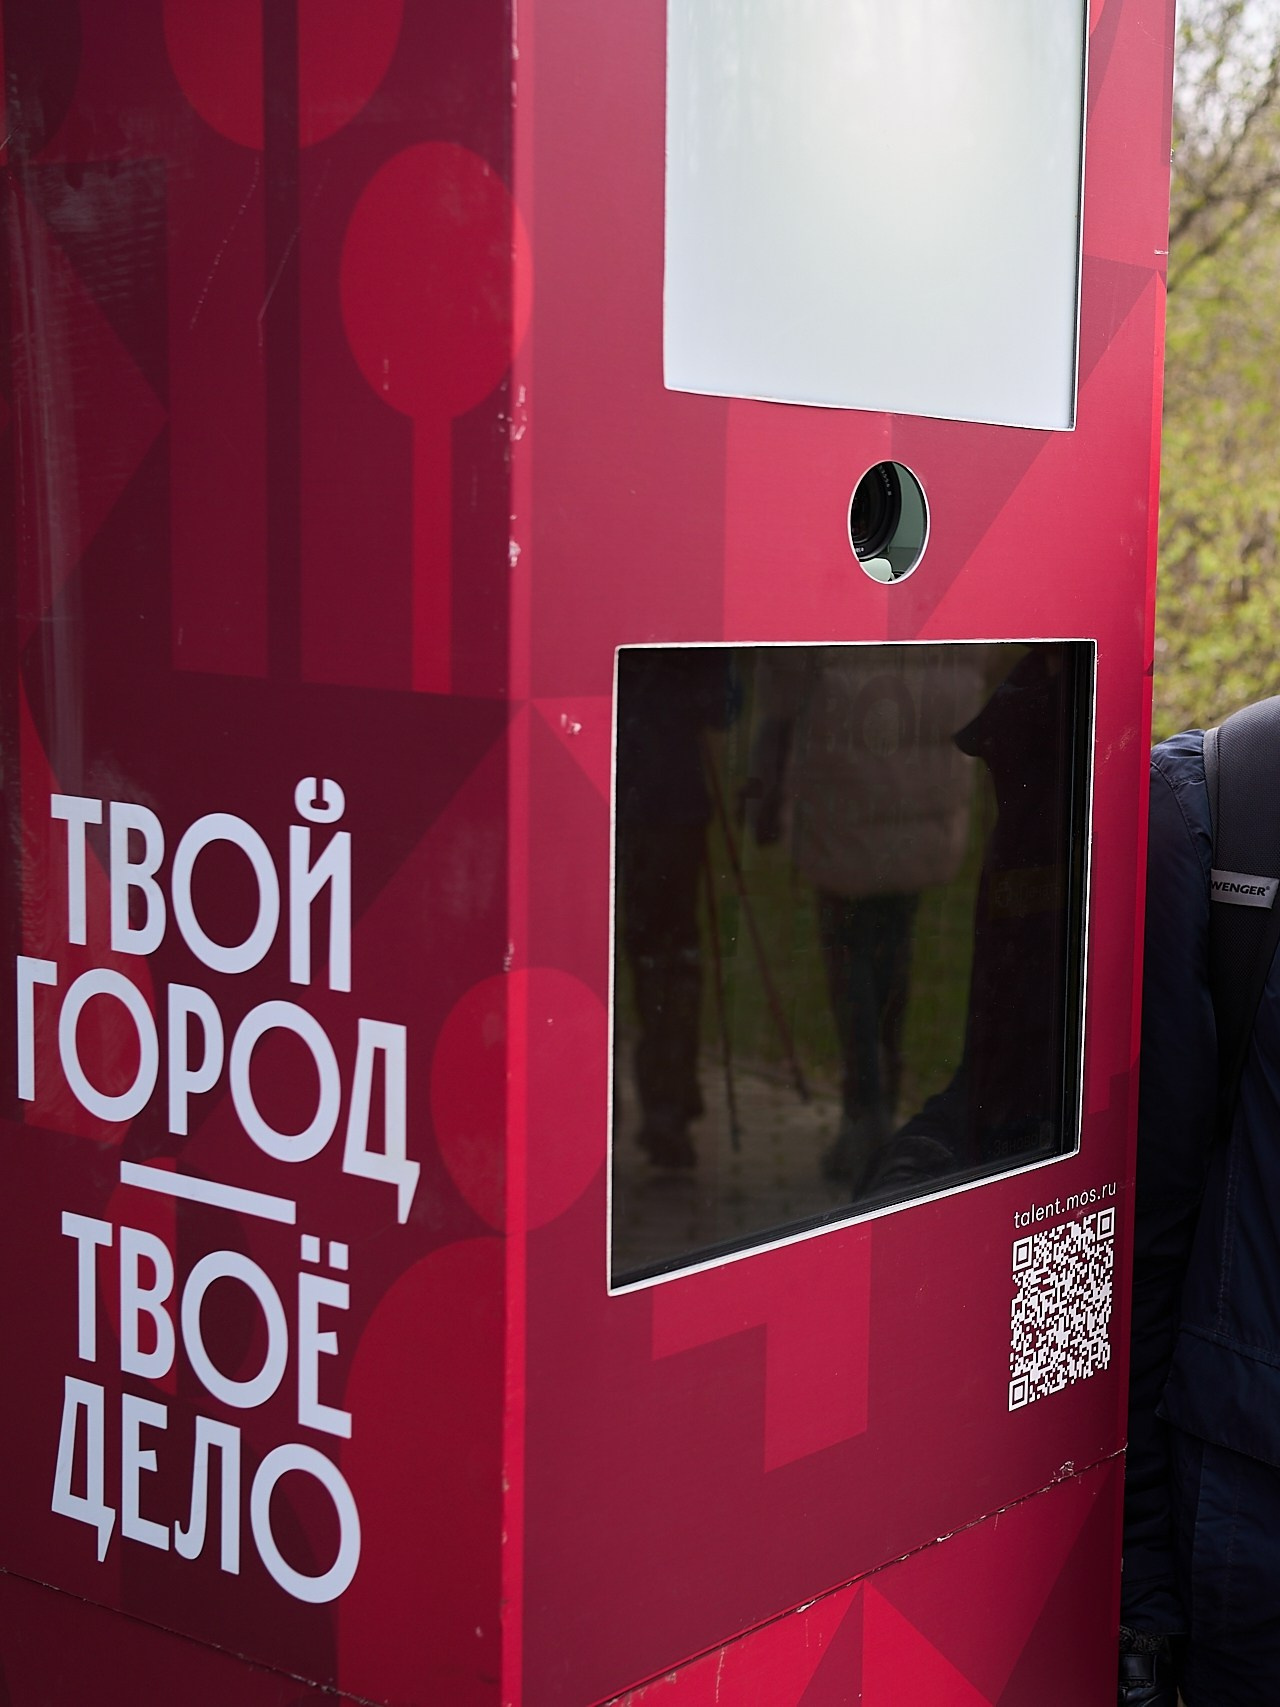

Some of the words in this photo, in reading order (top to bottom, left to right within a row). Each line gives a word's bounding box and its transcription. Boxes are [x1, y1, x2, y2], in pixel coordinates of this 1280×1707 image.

[50, 776, 352, 993] ТВОЙ
[1211, 881, 1266, 896] WENGER
[16, 955, 421, 1225] ГОРОД
[1014, 1182, 1116, 1229] talent.mos.ru
[61, 1210, 352, 1440] ТВОЁ
[51, 1375, 362, 1604] ДЕЛО
